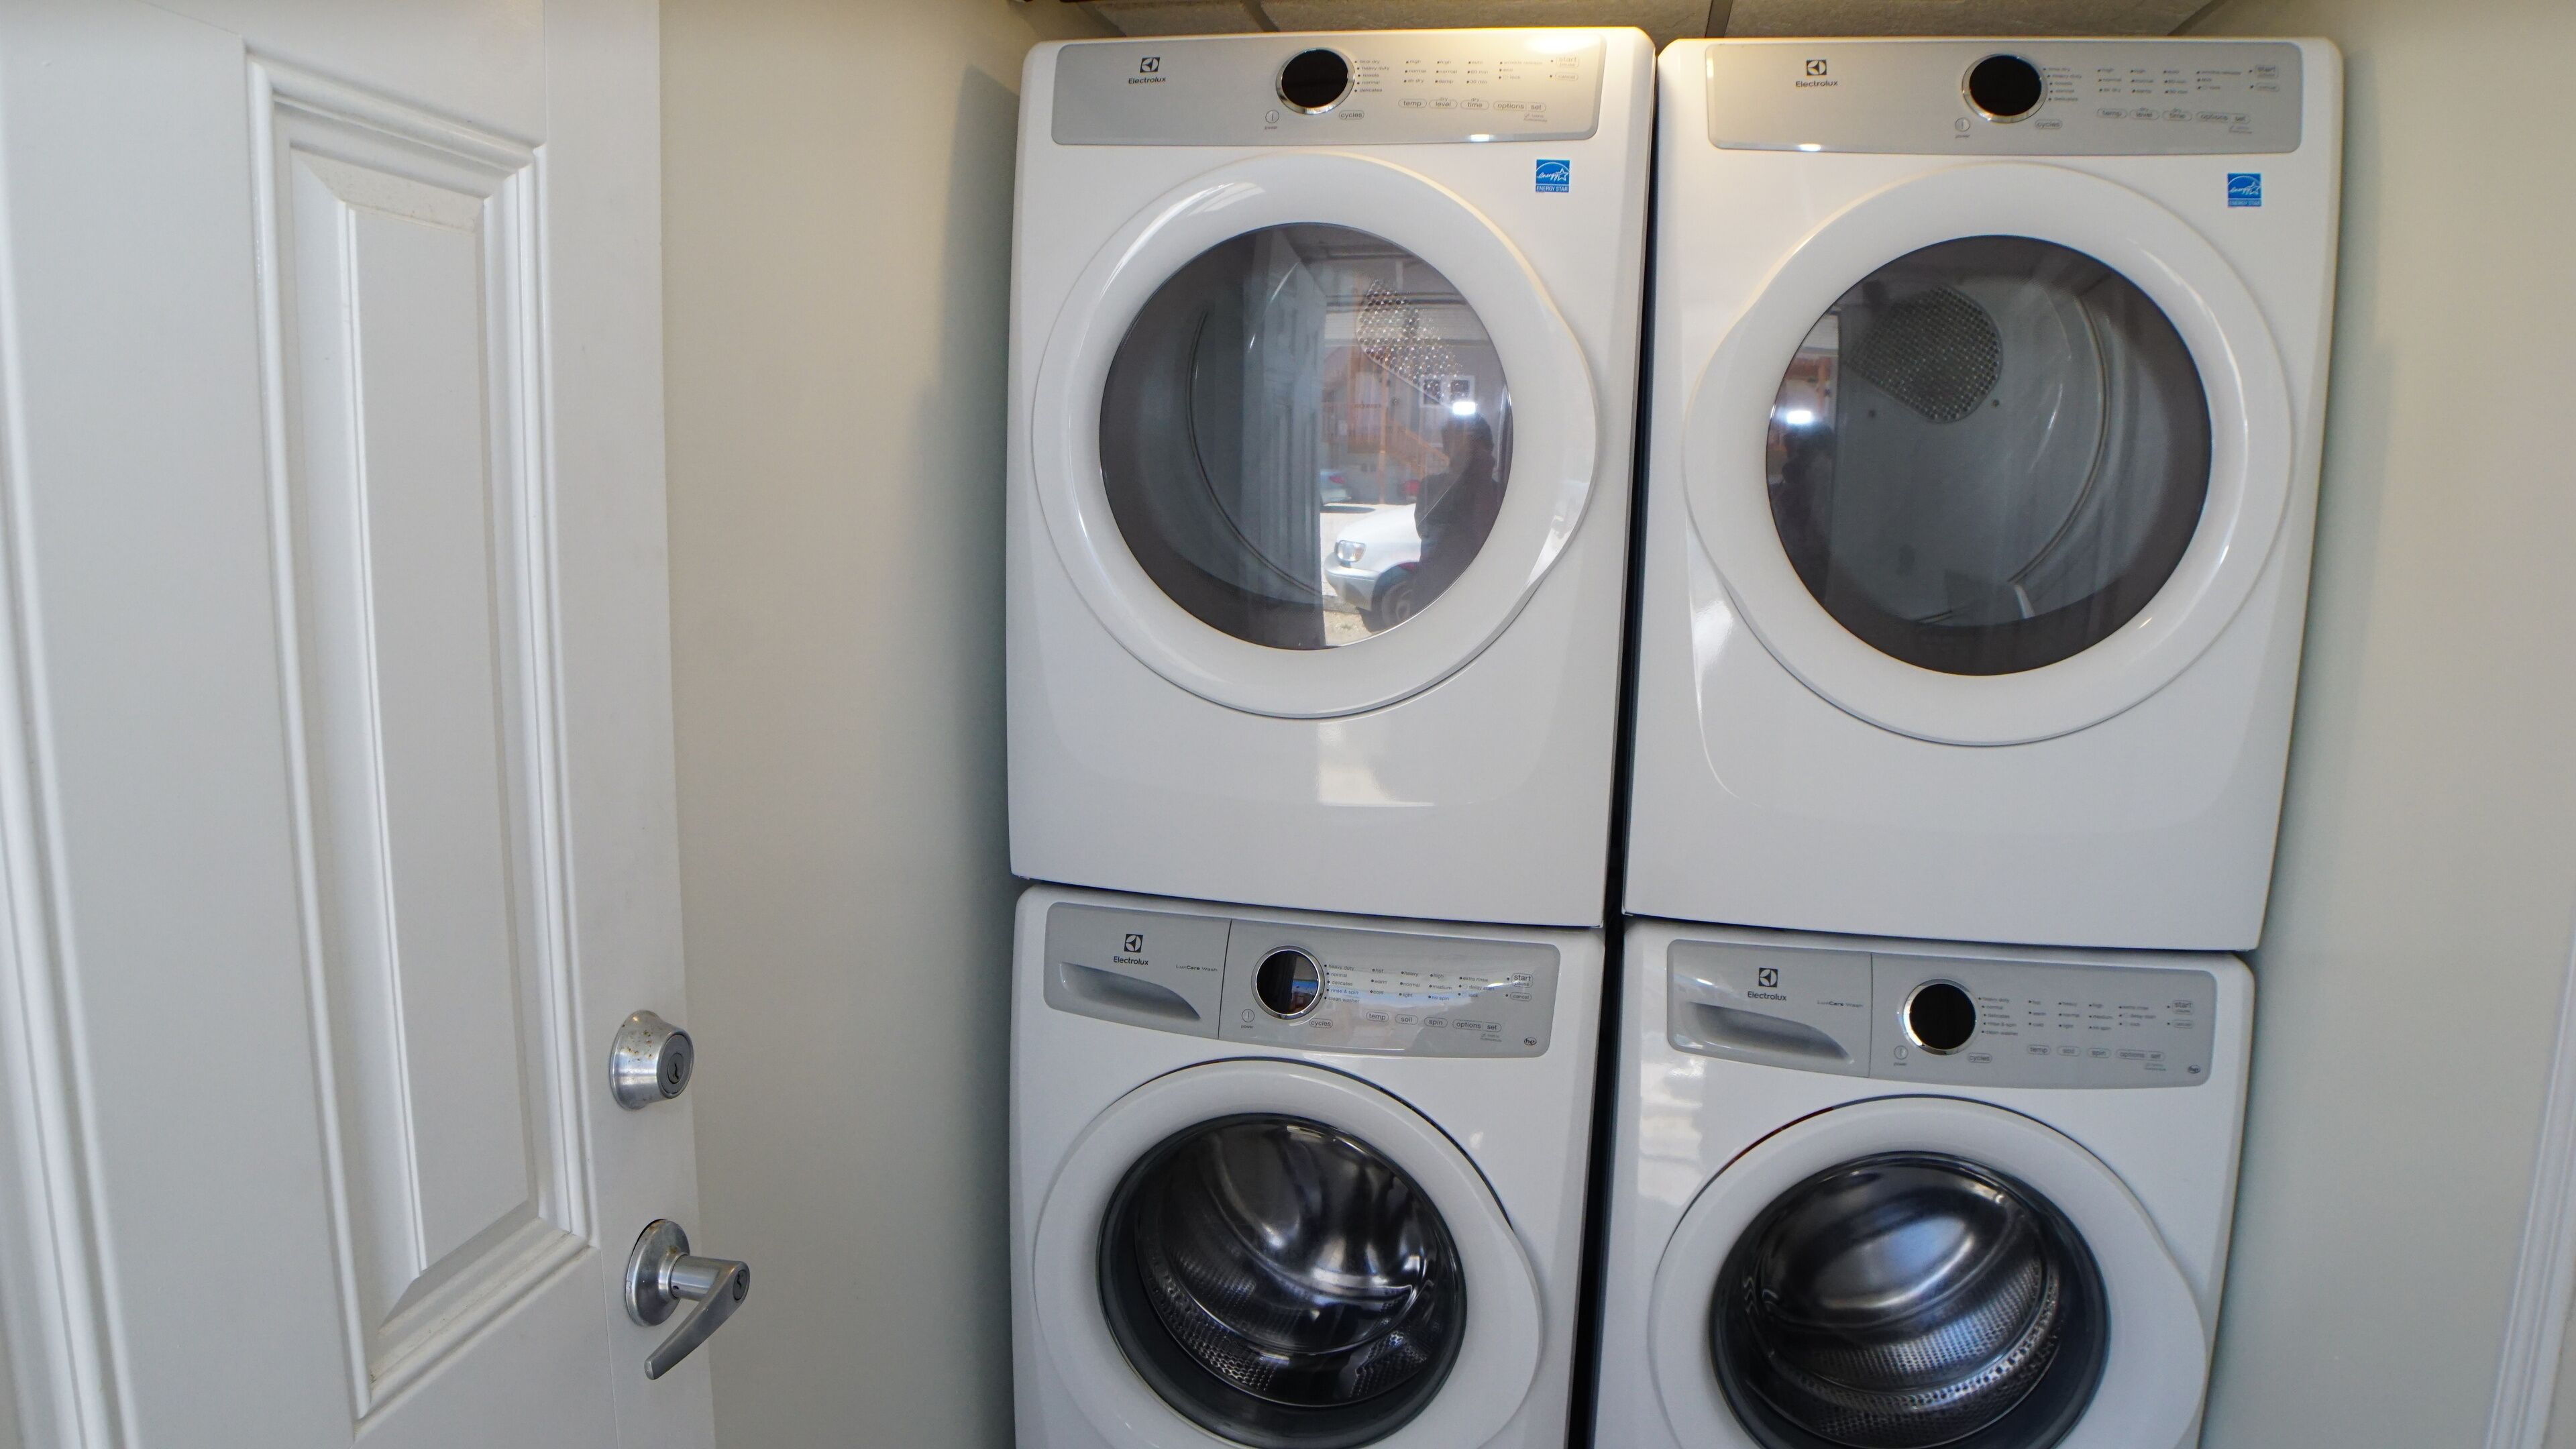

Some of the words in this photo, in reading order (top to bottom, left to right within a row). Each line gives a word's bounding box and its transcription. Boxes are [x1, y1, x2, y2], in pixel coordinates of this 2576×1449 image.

[1113, 956, 1148, 965] Electrolux
[1748, 991, 1787, 1001] Electrolux
[1369, 1013, 1386, 1021] temp
[1456, 1020, 1481, 1029] options
